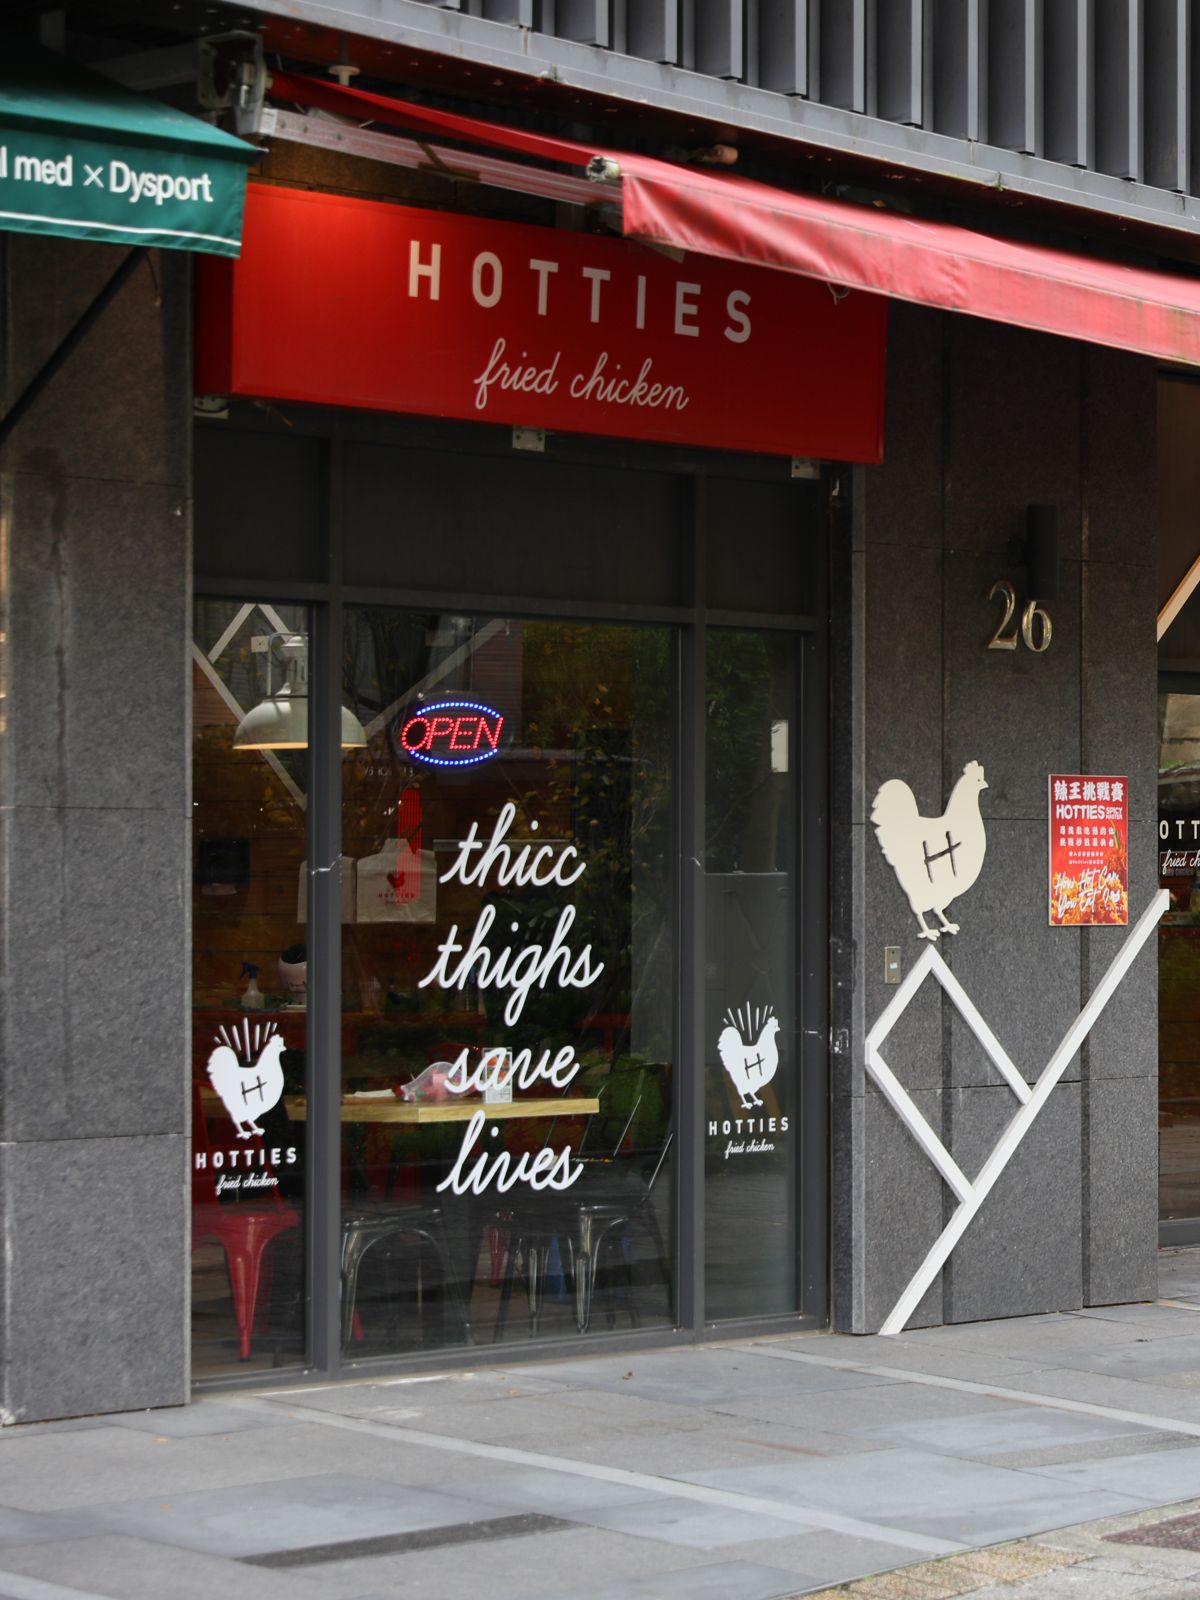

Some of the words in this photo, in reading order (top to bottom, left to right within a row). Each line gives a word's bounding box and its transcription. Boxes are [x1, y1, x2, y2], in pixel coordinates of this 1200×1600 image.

[14, 154, 73, 187] med
[109, 160, 214, 206] Dysport
[408, 239, 752, 344] HOTTIES
[474, 338, 562, 410] fried
[570, 352, 690, 410] chicken
[988, 580, 1053, 653] 26
[401, 716, 504, 751] OPEN
[1054, 780, 1124, 802] 辣王挑戰賽
[1056, 804, 1105, 820] HOTTIES
[1106, 807, 1123, 815] SPICY
[439, 802, 587, 887] thicc
[1162, 849, 1187, 875] fried
[1055, 872, 1077, 896] How
[1078, 867, 1100, 891] Hot
[1098, 865, 1119, 889] Can
[1058, 895, 1077, 918] You
[1079, 888, 1101, 913] Eat
[418, 904, 605, 1027] thighs
[444, 1045, 580, 1094] save
[708, 1116, 789, 1136] HOTTIES
[195, 1147, 297, 1170] HOTTIES
[436, 1110, 584, 1195] lives
[725, 1140, 745, 1159] fried
[746, 1138, 775, 1153] chicken
[216, 1174, 242, 1196] fried
[243, 1171, 279, 1188] chicken
